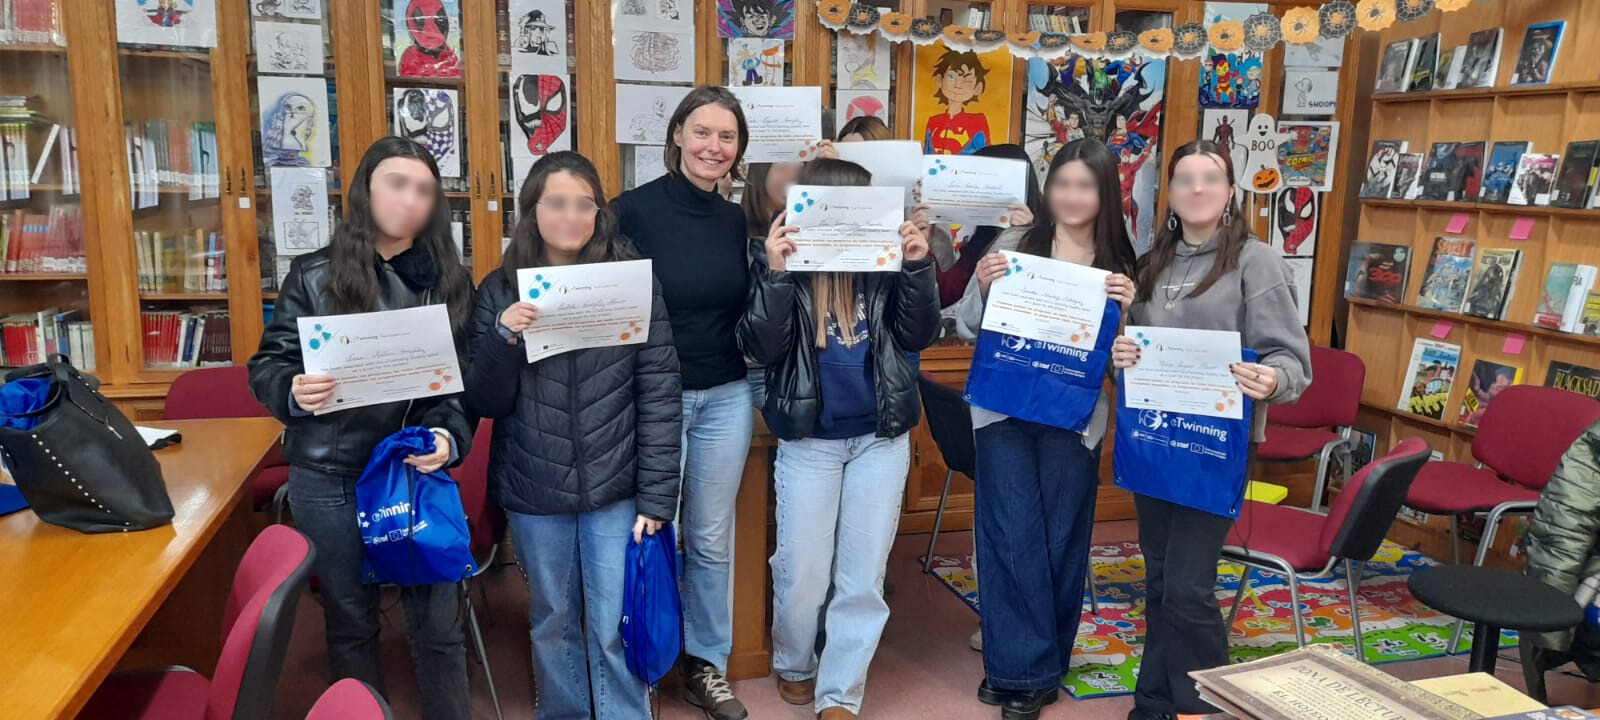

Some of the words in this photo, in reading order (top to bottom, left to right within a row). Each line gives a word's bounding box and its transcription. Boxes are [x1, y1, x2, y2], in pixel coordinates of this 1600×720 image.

[1251, 139, 1275, 151] BOO
[1553, 371, 1600, 398] BLACKSAD
[1170, 416, 1228, 442] eTwinning
[1290, 666, 1329, 683] ZONA
[1325, 681, 1352, 694] DE
